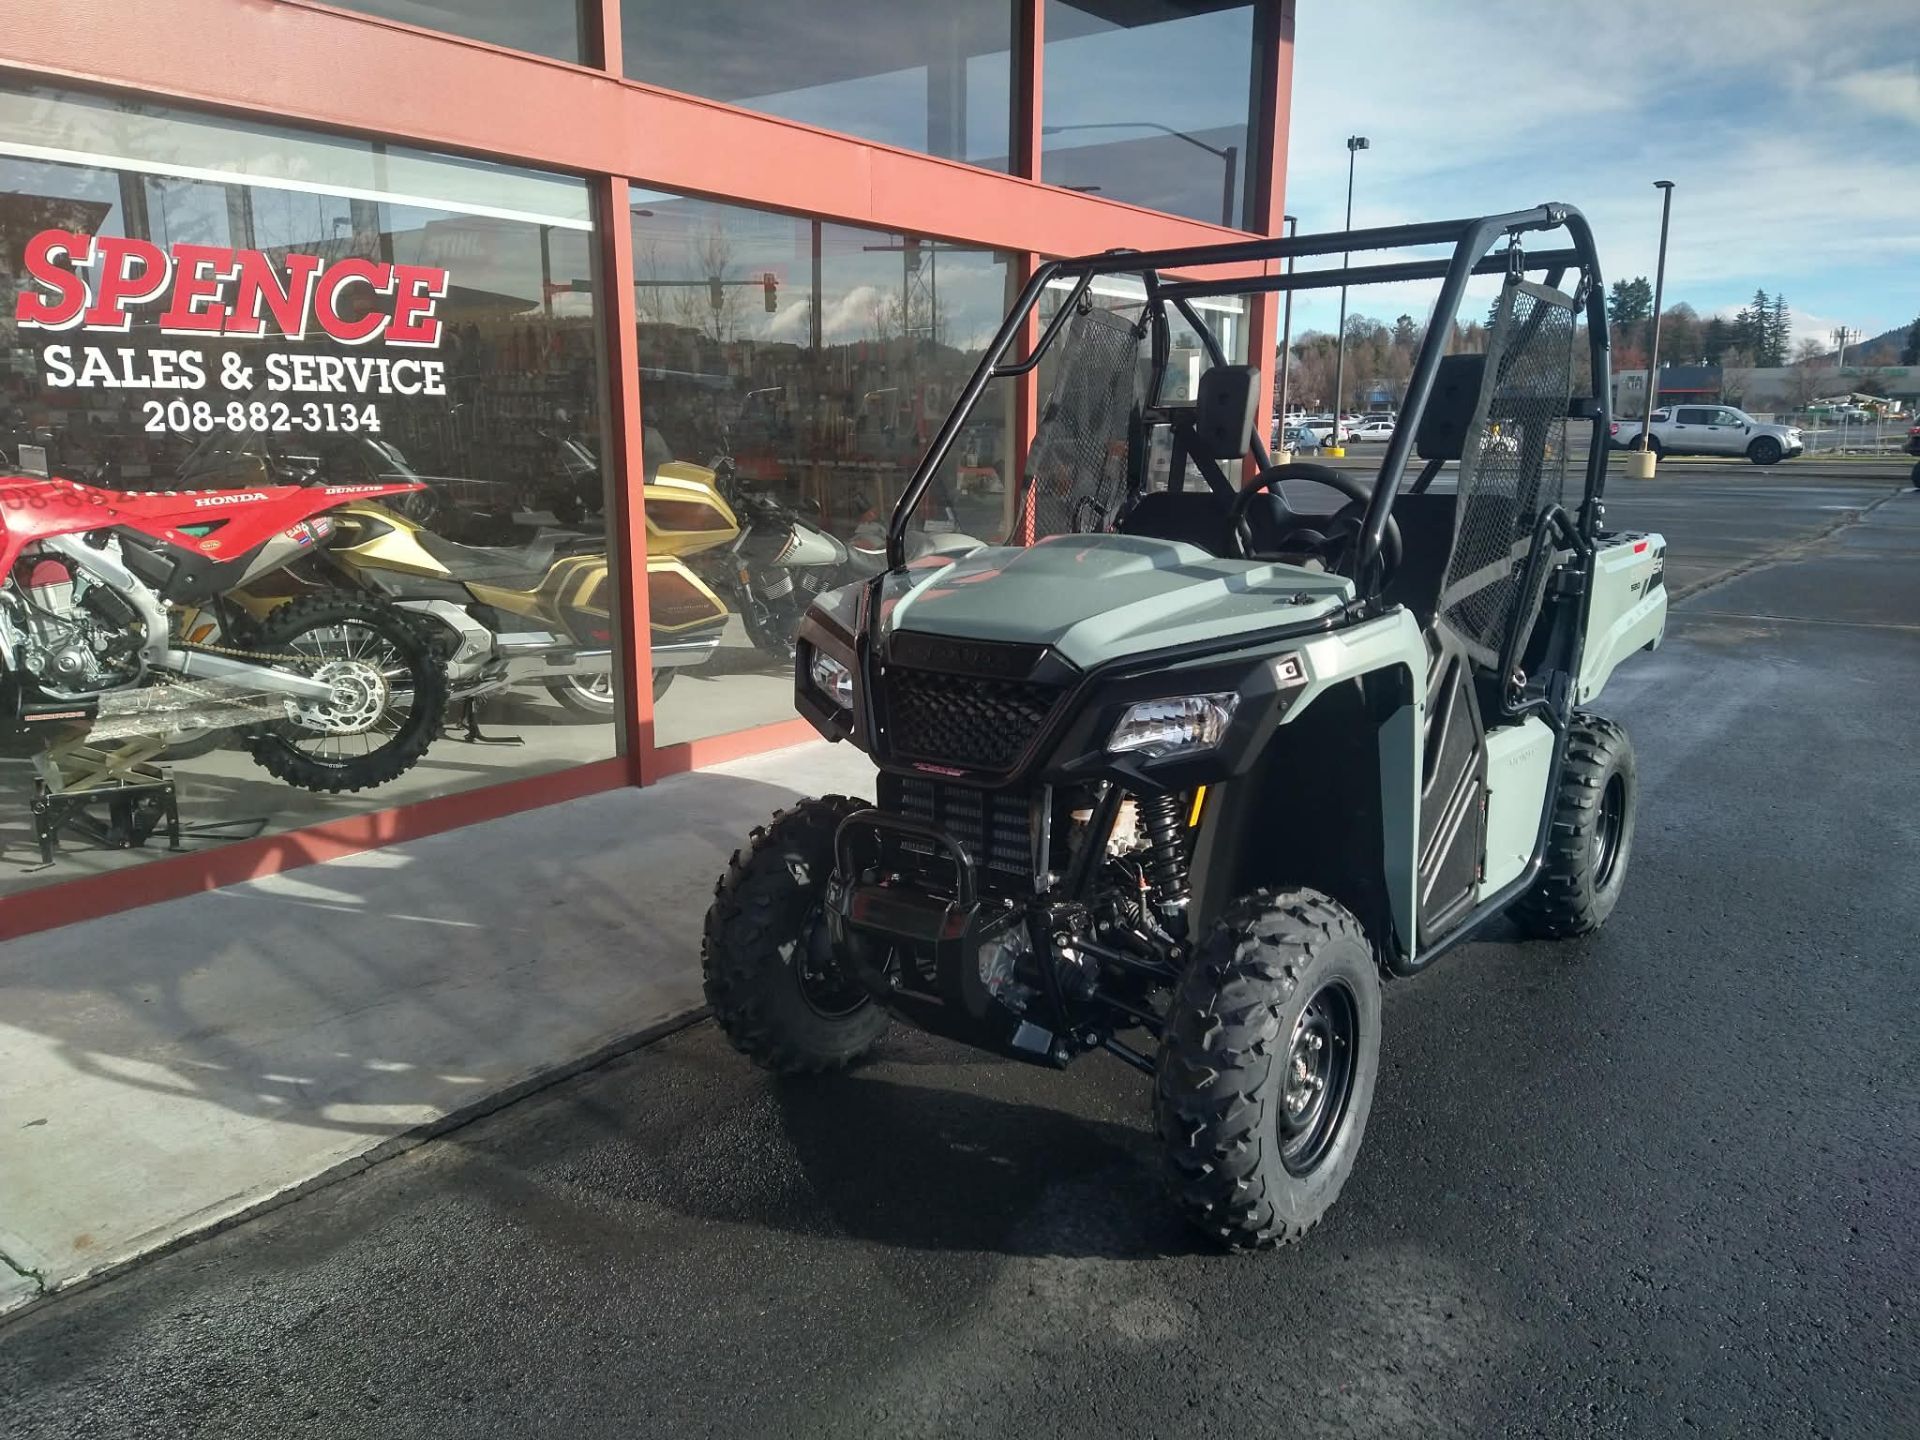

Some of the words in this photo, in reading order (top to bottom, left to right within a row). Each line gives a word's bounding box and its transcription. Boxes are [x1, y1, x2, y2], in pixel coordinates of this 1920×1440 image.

[16, 228, 448, 348] SPENCE
[44, 344, 206, 390] SALES
[221, 352, 253, 390] &
[267, 353, 446, 395] SERVICE
[143, 401, 380, 432] 208-882-3134
[195, 492, 269, 507] HONDA
[325, 485, 384, 495] DUNLOP
